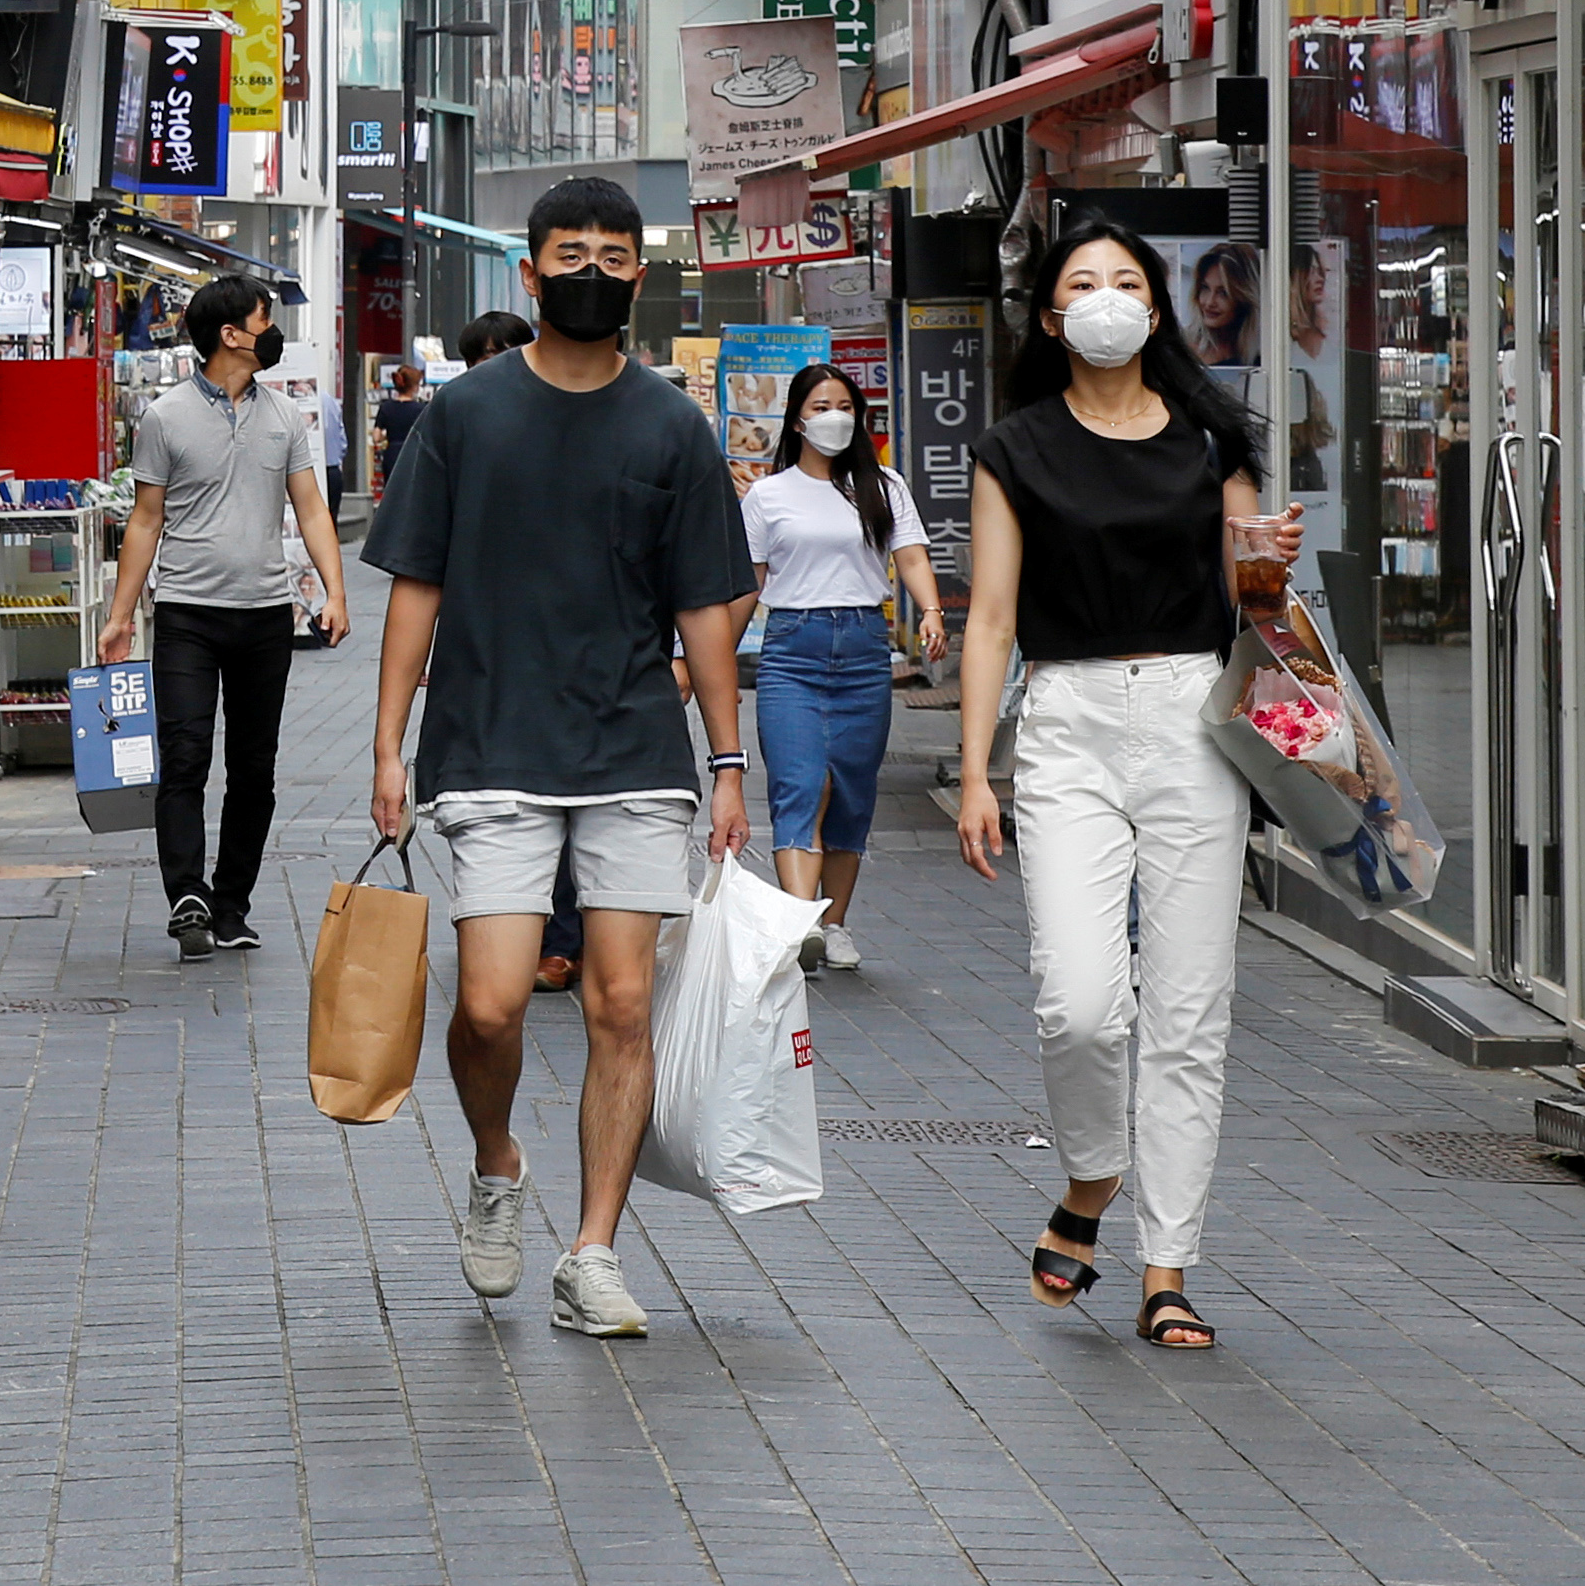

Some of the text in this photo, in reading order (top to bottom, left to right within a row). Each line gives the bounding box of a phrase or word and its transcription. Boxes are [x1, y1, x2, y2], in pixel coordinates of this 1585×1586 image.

[165, 35, 201, 66] K
[698, 158, 737, 173] James
[952, 338, 980, 358] 4F
[110, 671, 146, 695] 5E
[110, 693, 147, 712] UTP
[793, 1033, 811, 1050] UNI
